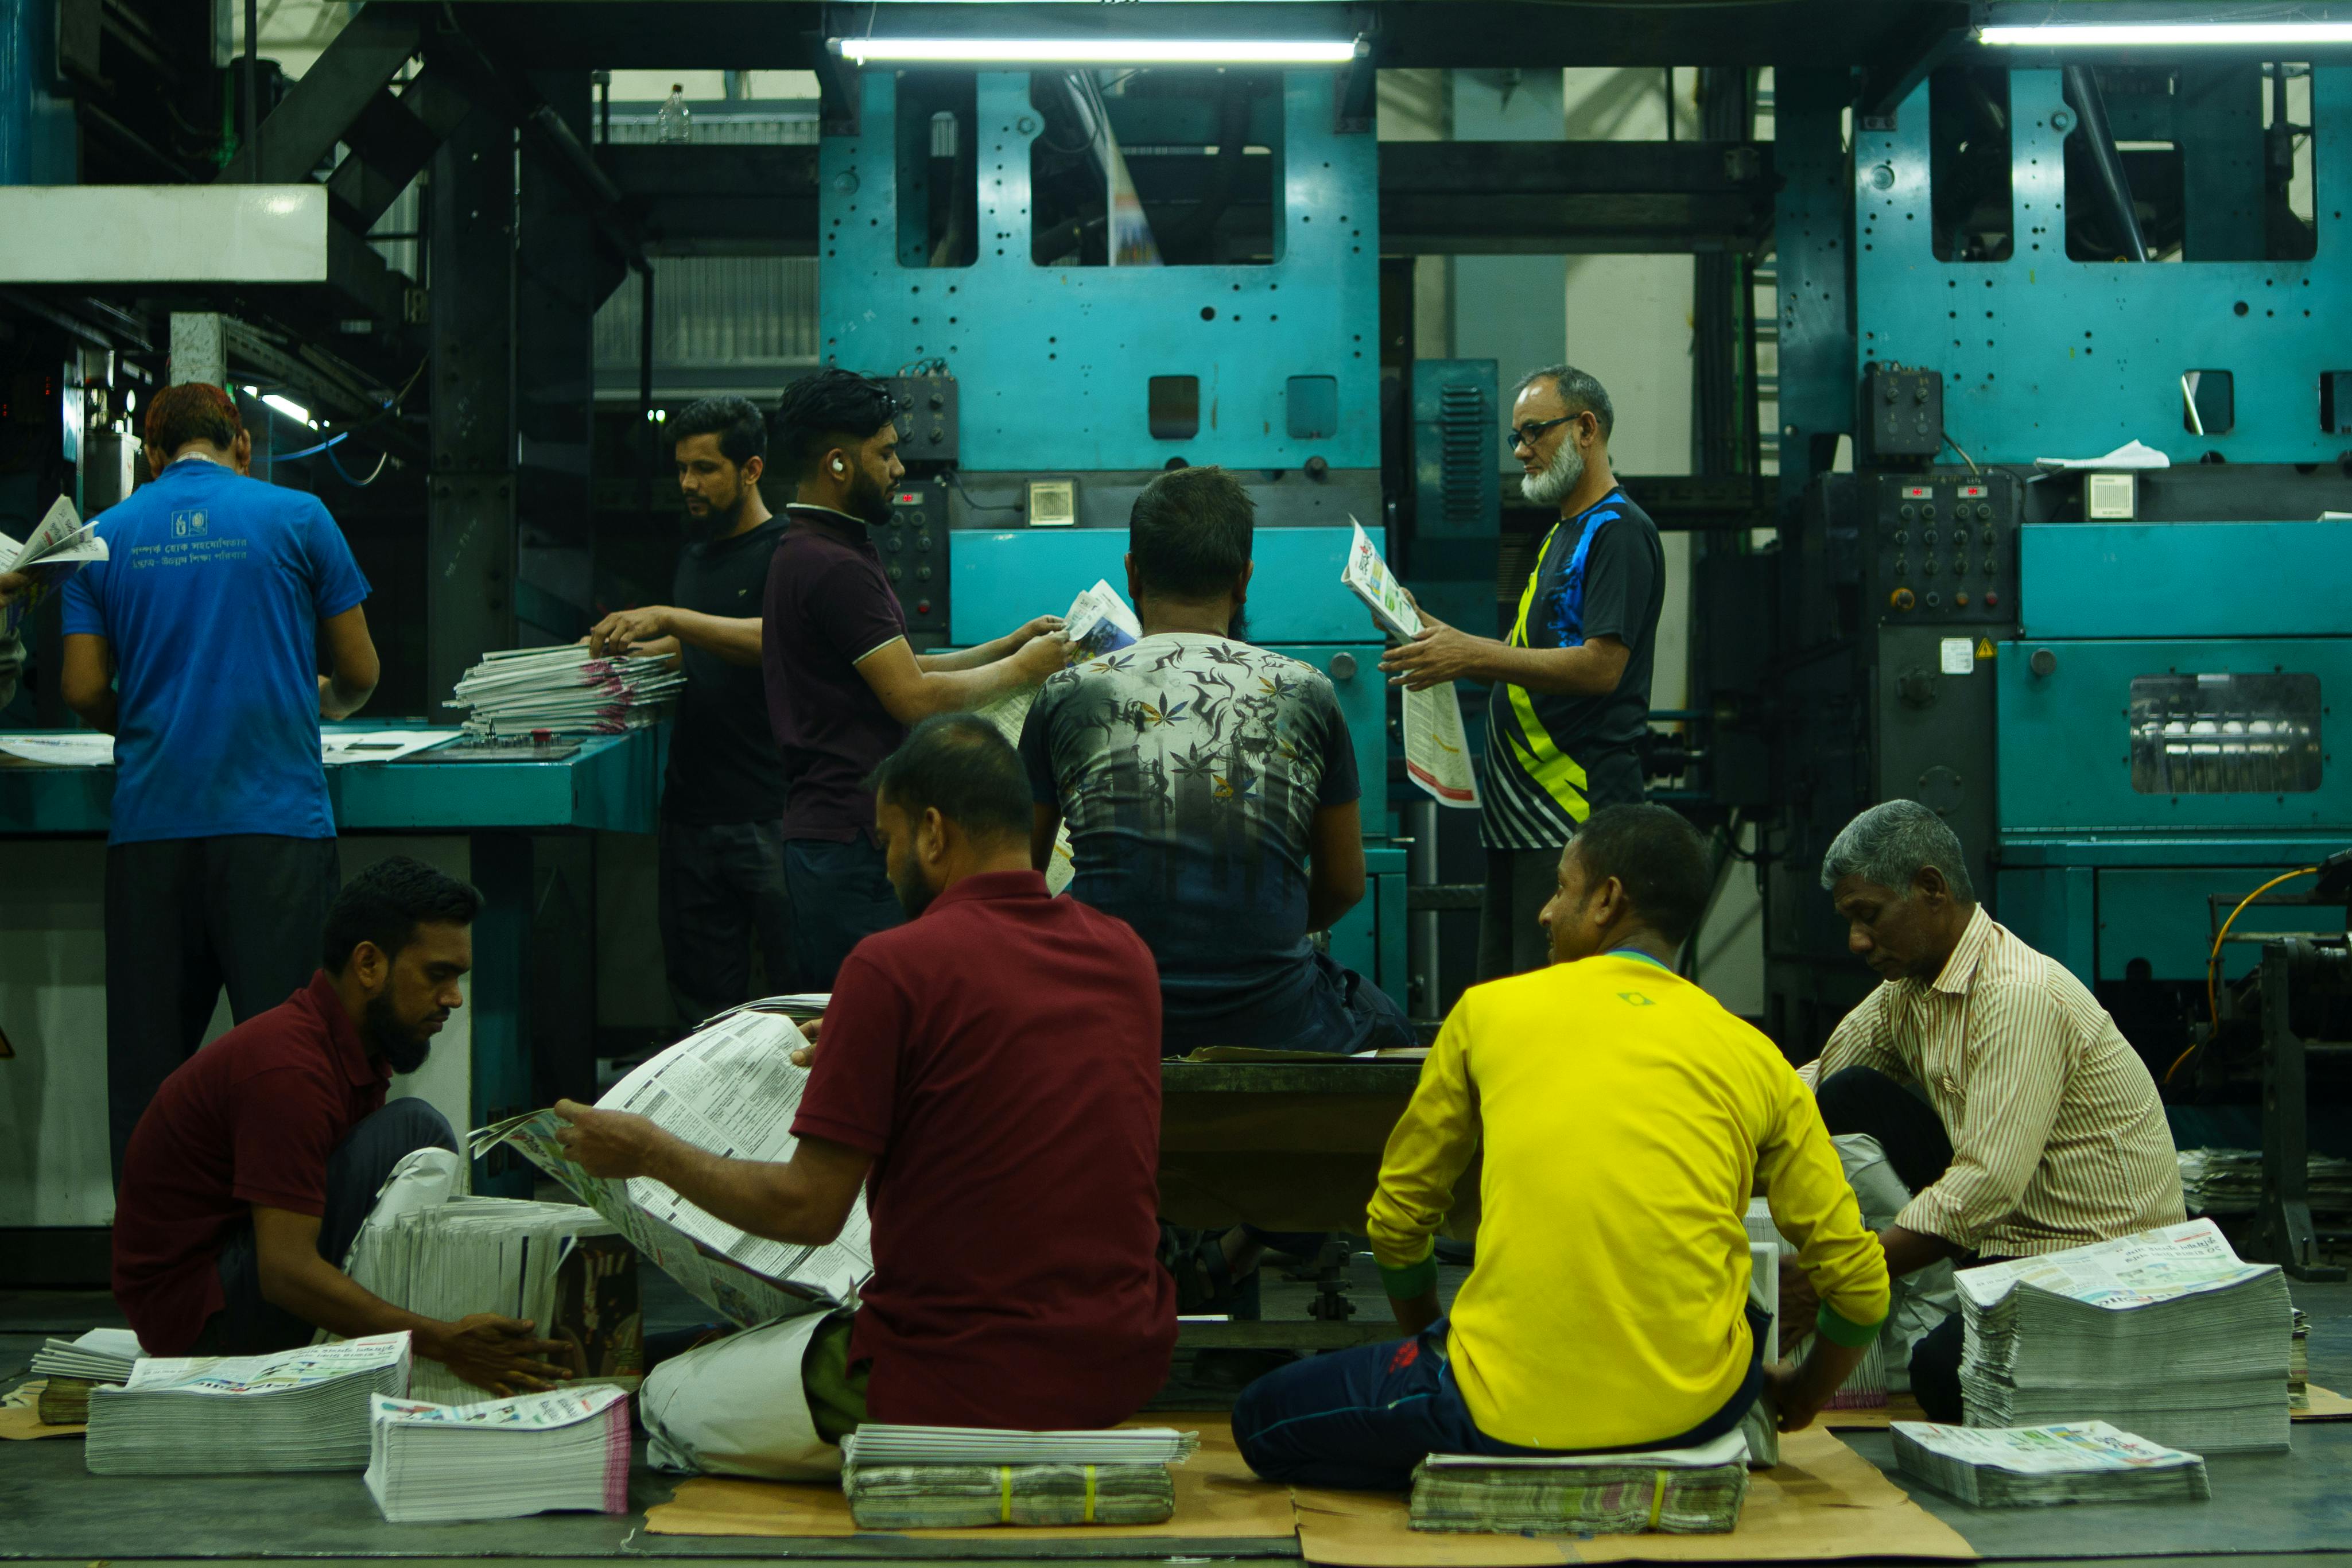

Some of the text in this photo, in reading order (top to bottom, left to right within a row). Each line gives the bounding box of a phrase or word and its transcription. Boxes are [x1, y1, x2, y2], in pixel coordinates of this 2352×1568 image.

[165, 542, 188, 553] হোক
[190, 552, 211, 563] শিক্ষা
[215, 550, 247, 561] পরিবার
